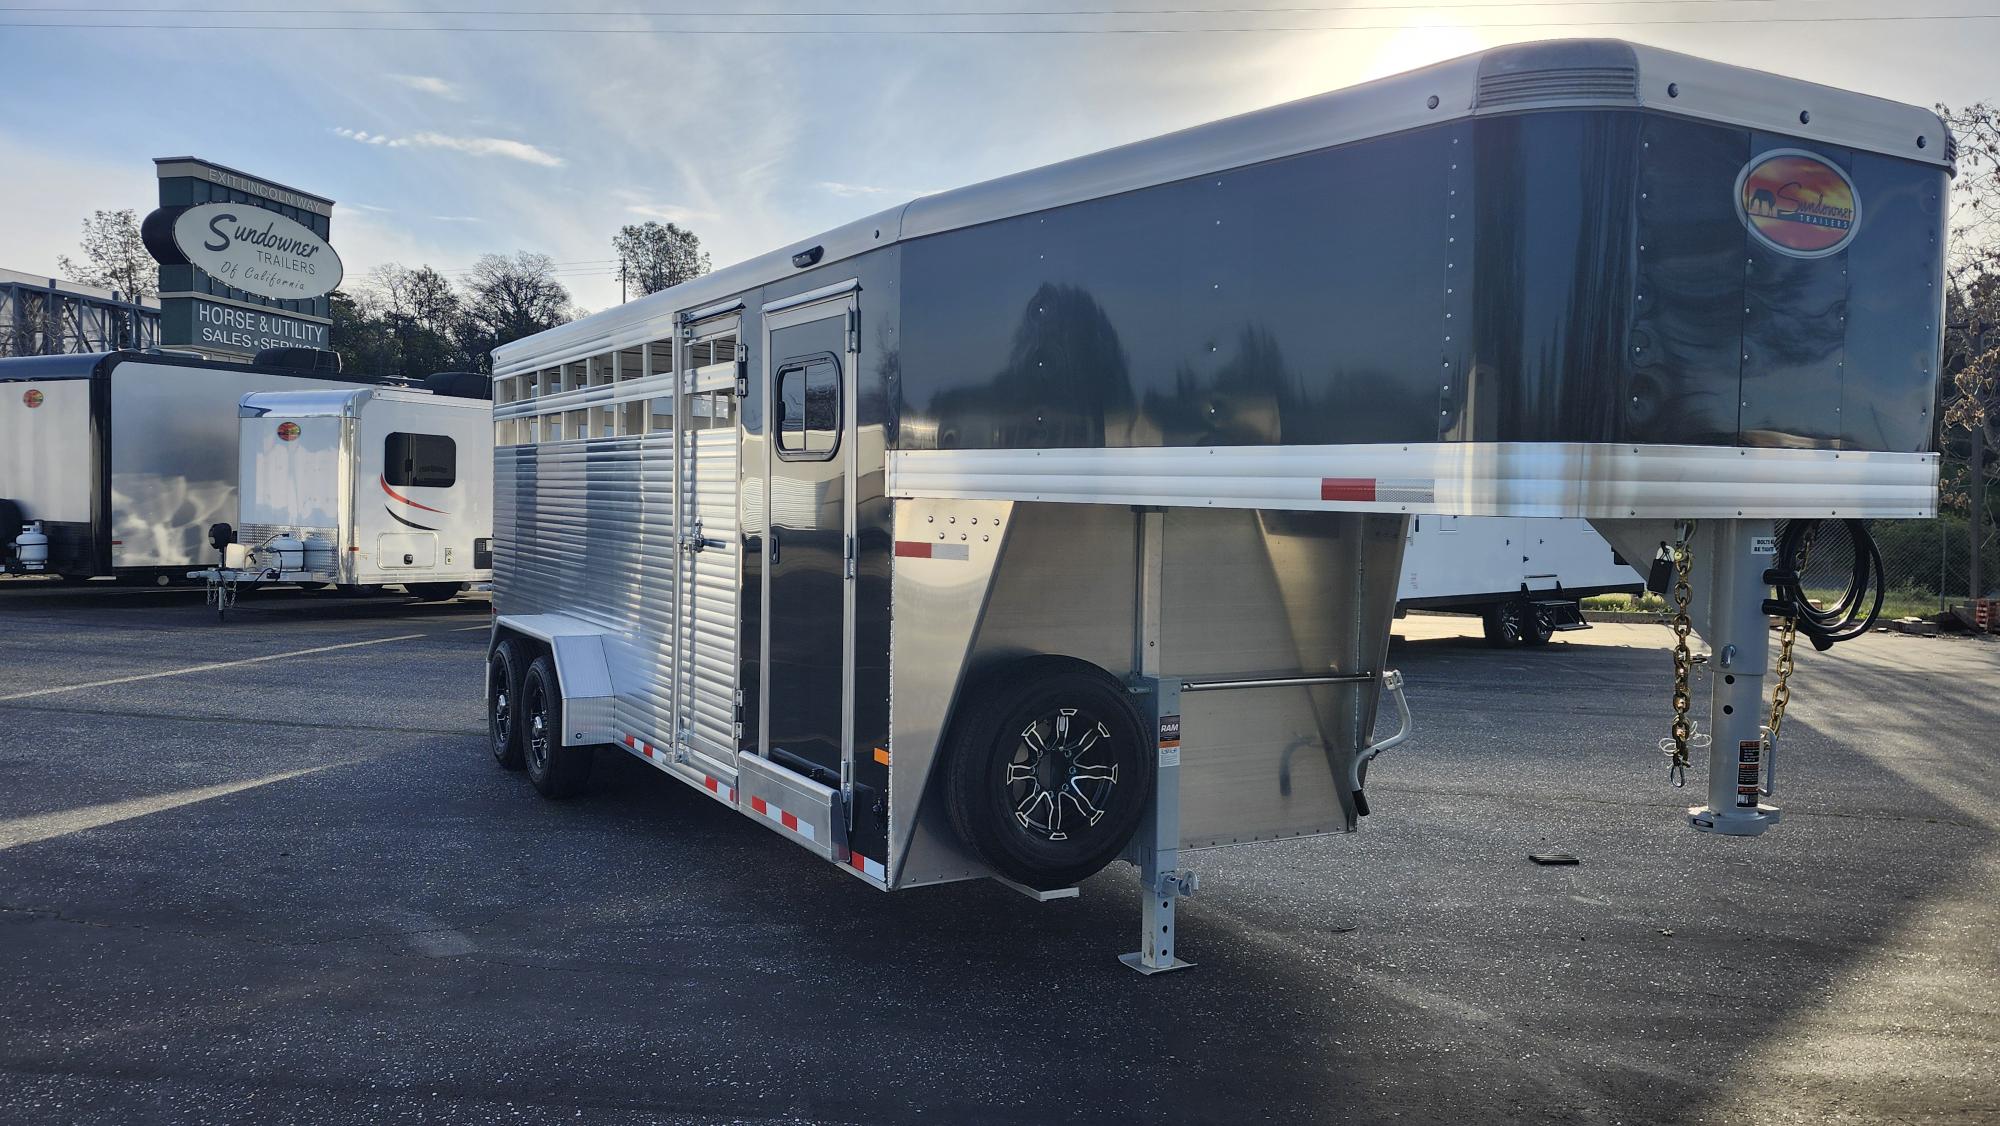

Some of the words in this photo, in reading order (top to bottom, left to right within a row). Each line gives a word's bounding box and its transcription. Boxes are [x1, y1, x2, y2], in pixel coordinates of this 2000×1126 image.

[208, 168, 239, 188] EXIT
[240, 178, 294, 203] LINCOLN
[296, 194, 321, 212] WAY
[1800, 214, 1849, 229] TRAILERS
[204, 213, 319, 258] Sundowner
[220, 261, 239, 279] Of
[244, 266, 305, 290] California
[256, 250, 316, 275] TRAILERS
[199, 303, 255, 331] HORSE
[259, 315, 269, 333] &
[272, 318, 323, 343] UTILITY
[202, 327, 252, 348] SALES
[1161, 723, 1178, 732] RAM
